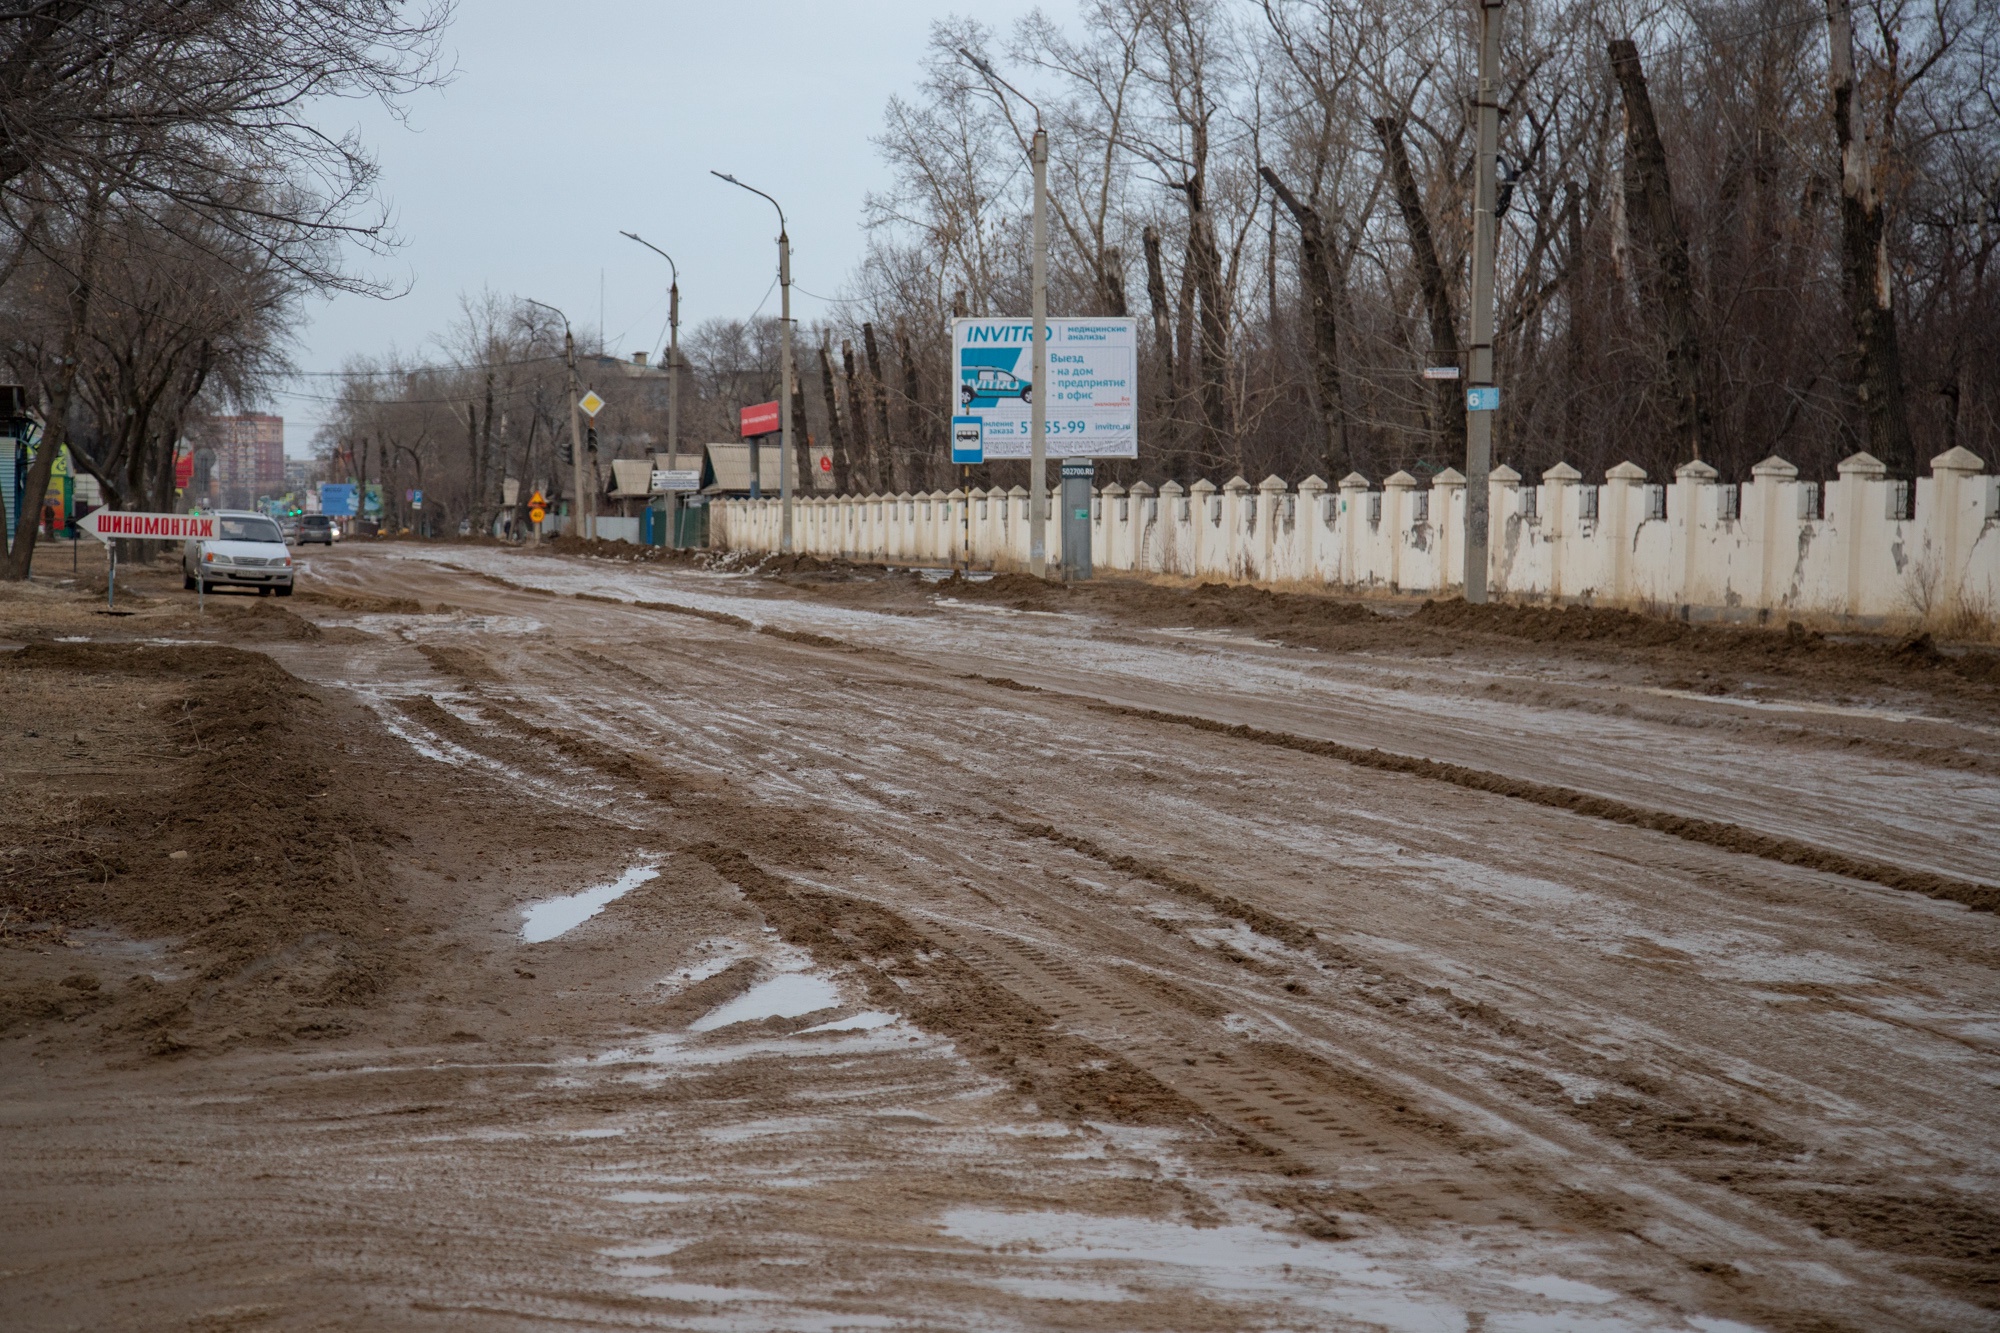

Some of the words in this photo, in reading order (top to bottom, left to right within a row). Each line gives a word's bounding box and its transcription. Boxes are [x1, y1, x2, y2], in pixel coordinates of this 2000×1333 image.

[1067, 326, 1127, 334] медицинские
[1051, 353, 1084, 363] Выезд
[1058, 380, 1126, 389] предприятие
[1067, 390, 1093, 401] офис
[1469, 393, 1480, 407] 6
[98, 515, 213, 537] ШИНОМОНТАЖ
